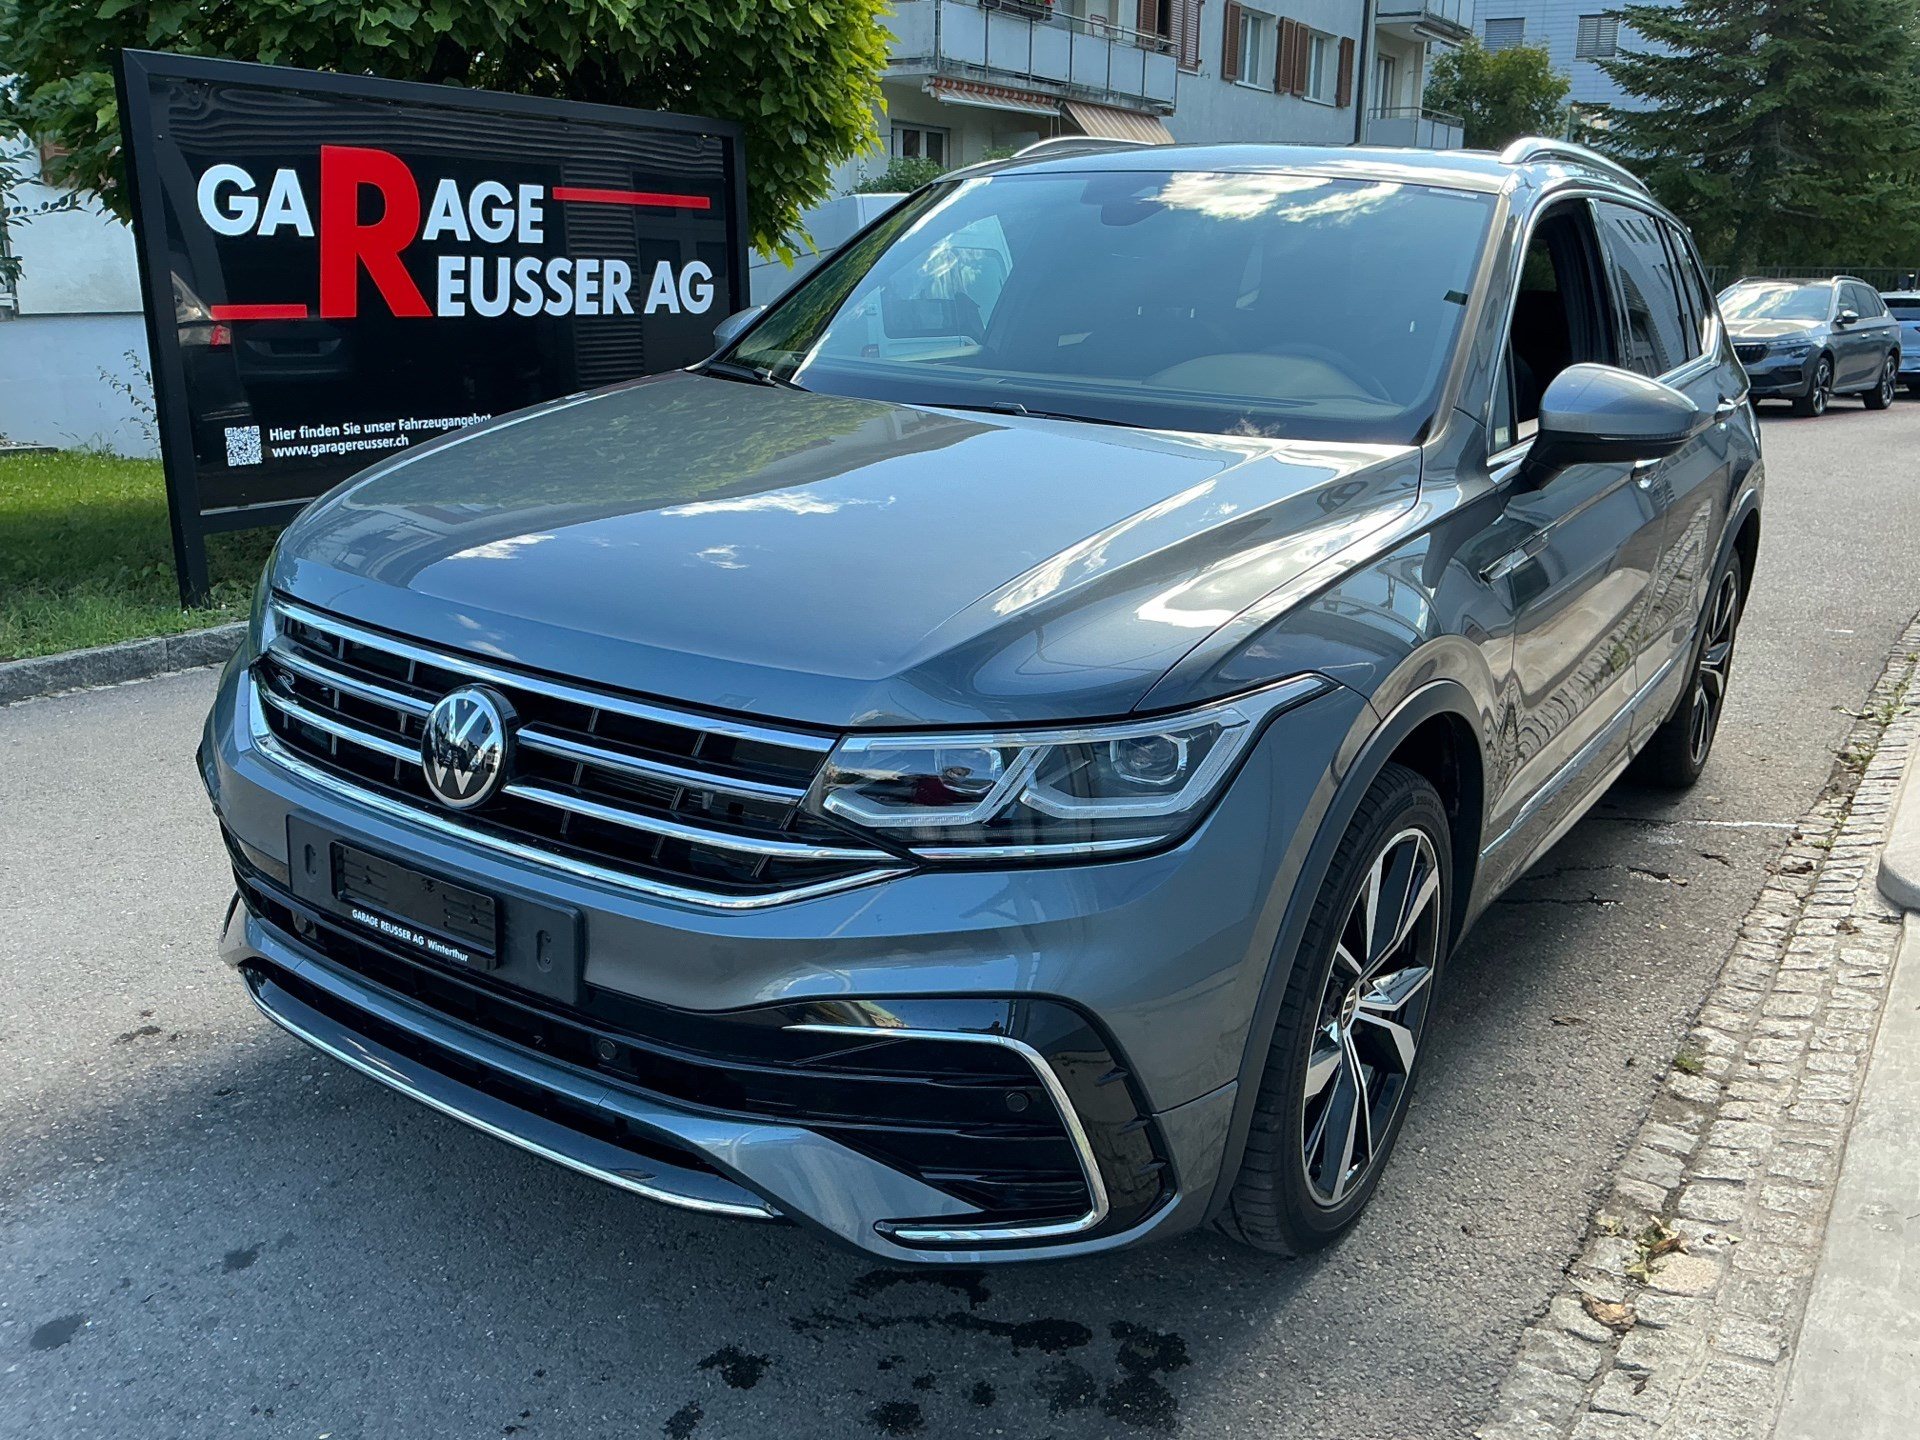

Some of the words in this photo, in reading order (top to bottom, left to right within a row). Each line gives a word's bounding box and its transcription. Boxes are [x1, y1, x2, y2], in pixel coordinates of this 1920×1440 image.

[197, 144, 544, 318] GARAGE
[644, 260, 714, 315] AG
[269, 427, 296, 442] Hier
[299, 422, 340, 439] finden
[343, 420, 361, 436] Sie
[364, 419, 396, 434] unser
[271, 434, 409, 458] www.garagereusser.ch
[352, 909, 378, 927] GARAGE
[380, 921, 411, 940] REUSSER
[412, 933, 425, 946] AG
[427, 939, 468, 961] Winterthur
